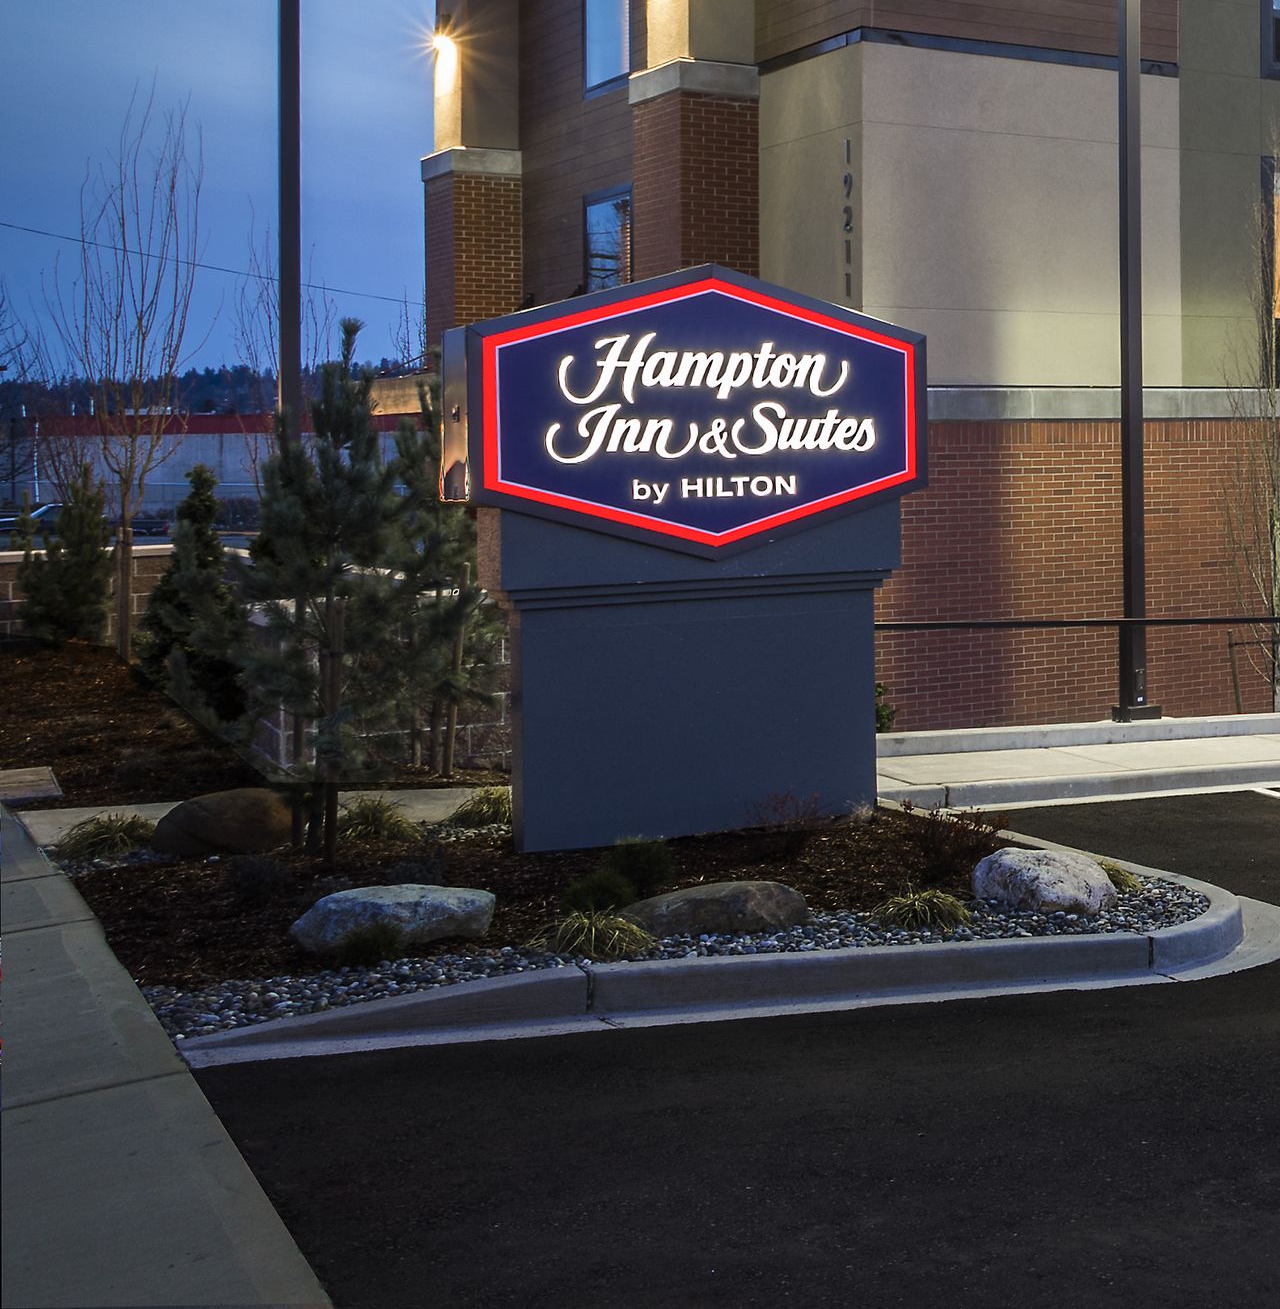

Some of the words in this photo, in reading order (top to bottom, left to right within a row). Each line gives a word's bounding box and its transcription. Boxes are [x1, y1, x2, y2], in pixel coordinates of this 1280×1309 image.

[842, 139, 853, 298] 19211
[557, 331, 848, 404] Hampton
[545, 403, 699, 465] Inn
[698, 417, 738, 459] &
[730, 401, 877, 455] Suites
[632, 478, 670, 505] by
[681, 475, 797, 499] HILTON
